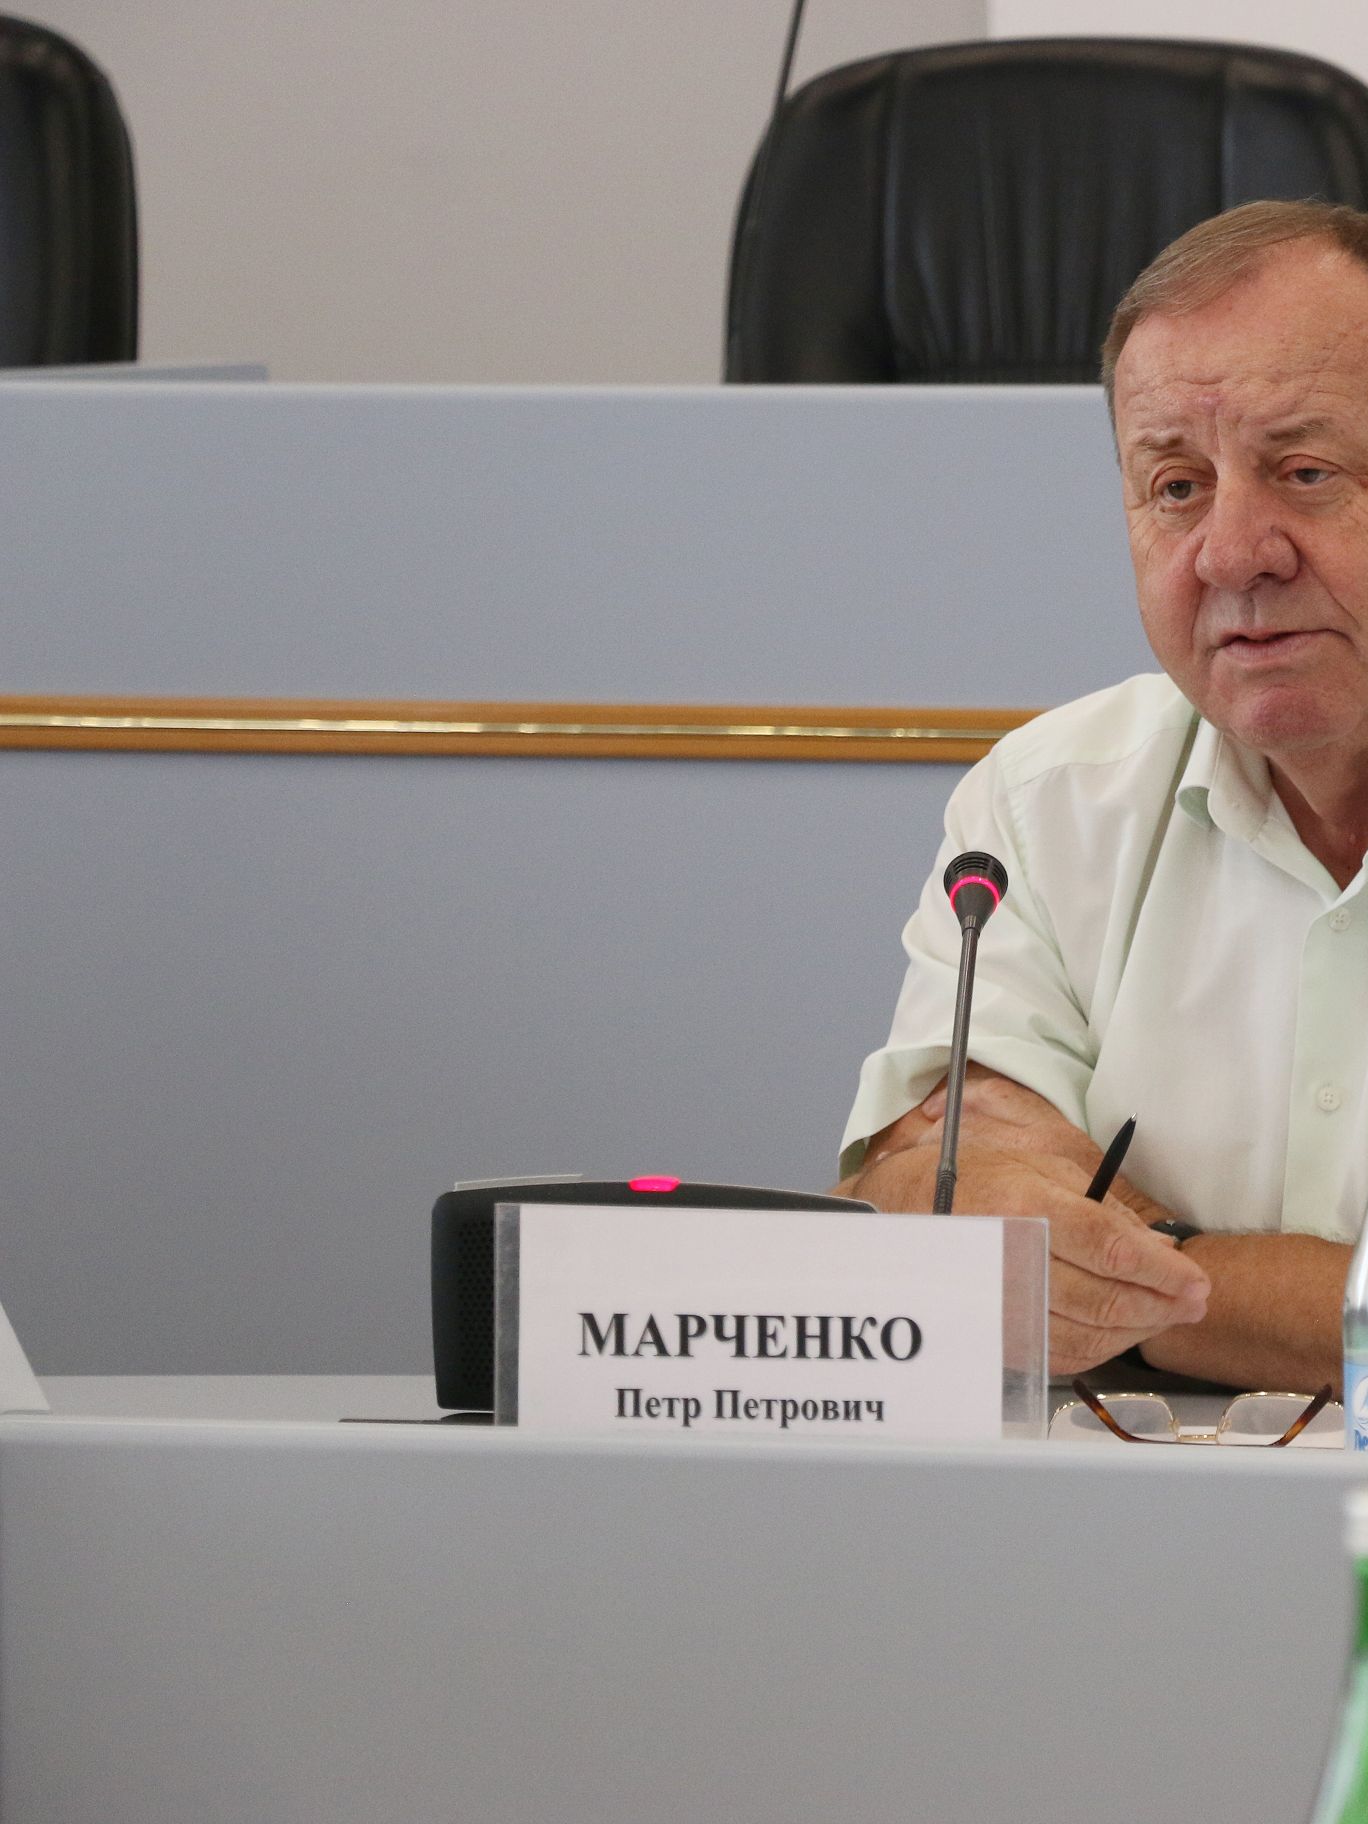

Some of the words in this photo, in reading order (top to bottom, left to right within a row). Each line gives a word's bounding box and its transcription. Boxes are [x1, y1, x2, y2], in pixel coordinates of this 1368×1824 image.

[578, 1312, 922, 1361] МАРЧЕНКО
[615, 1388, 702, 1427] Петр
[713, 1389, 885, 1428] Петрович
